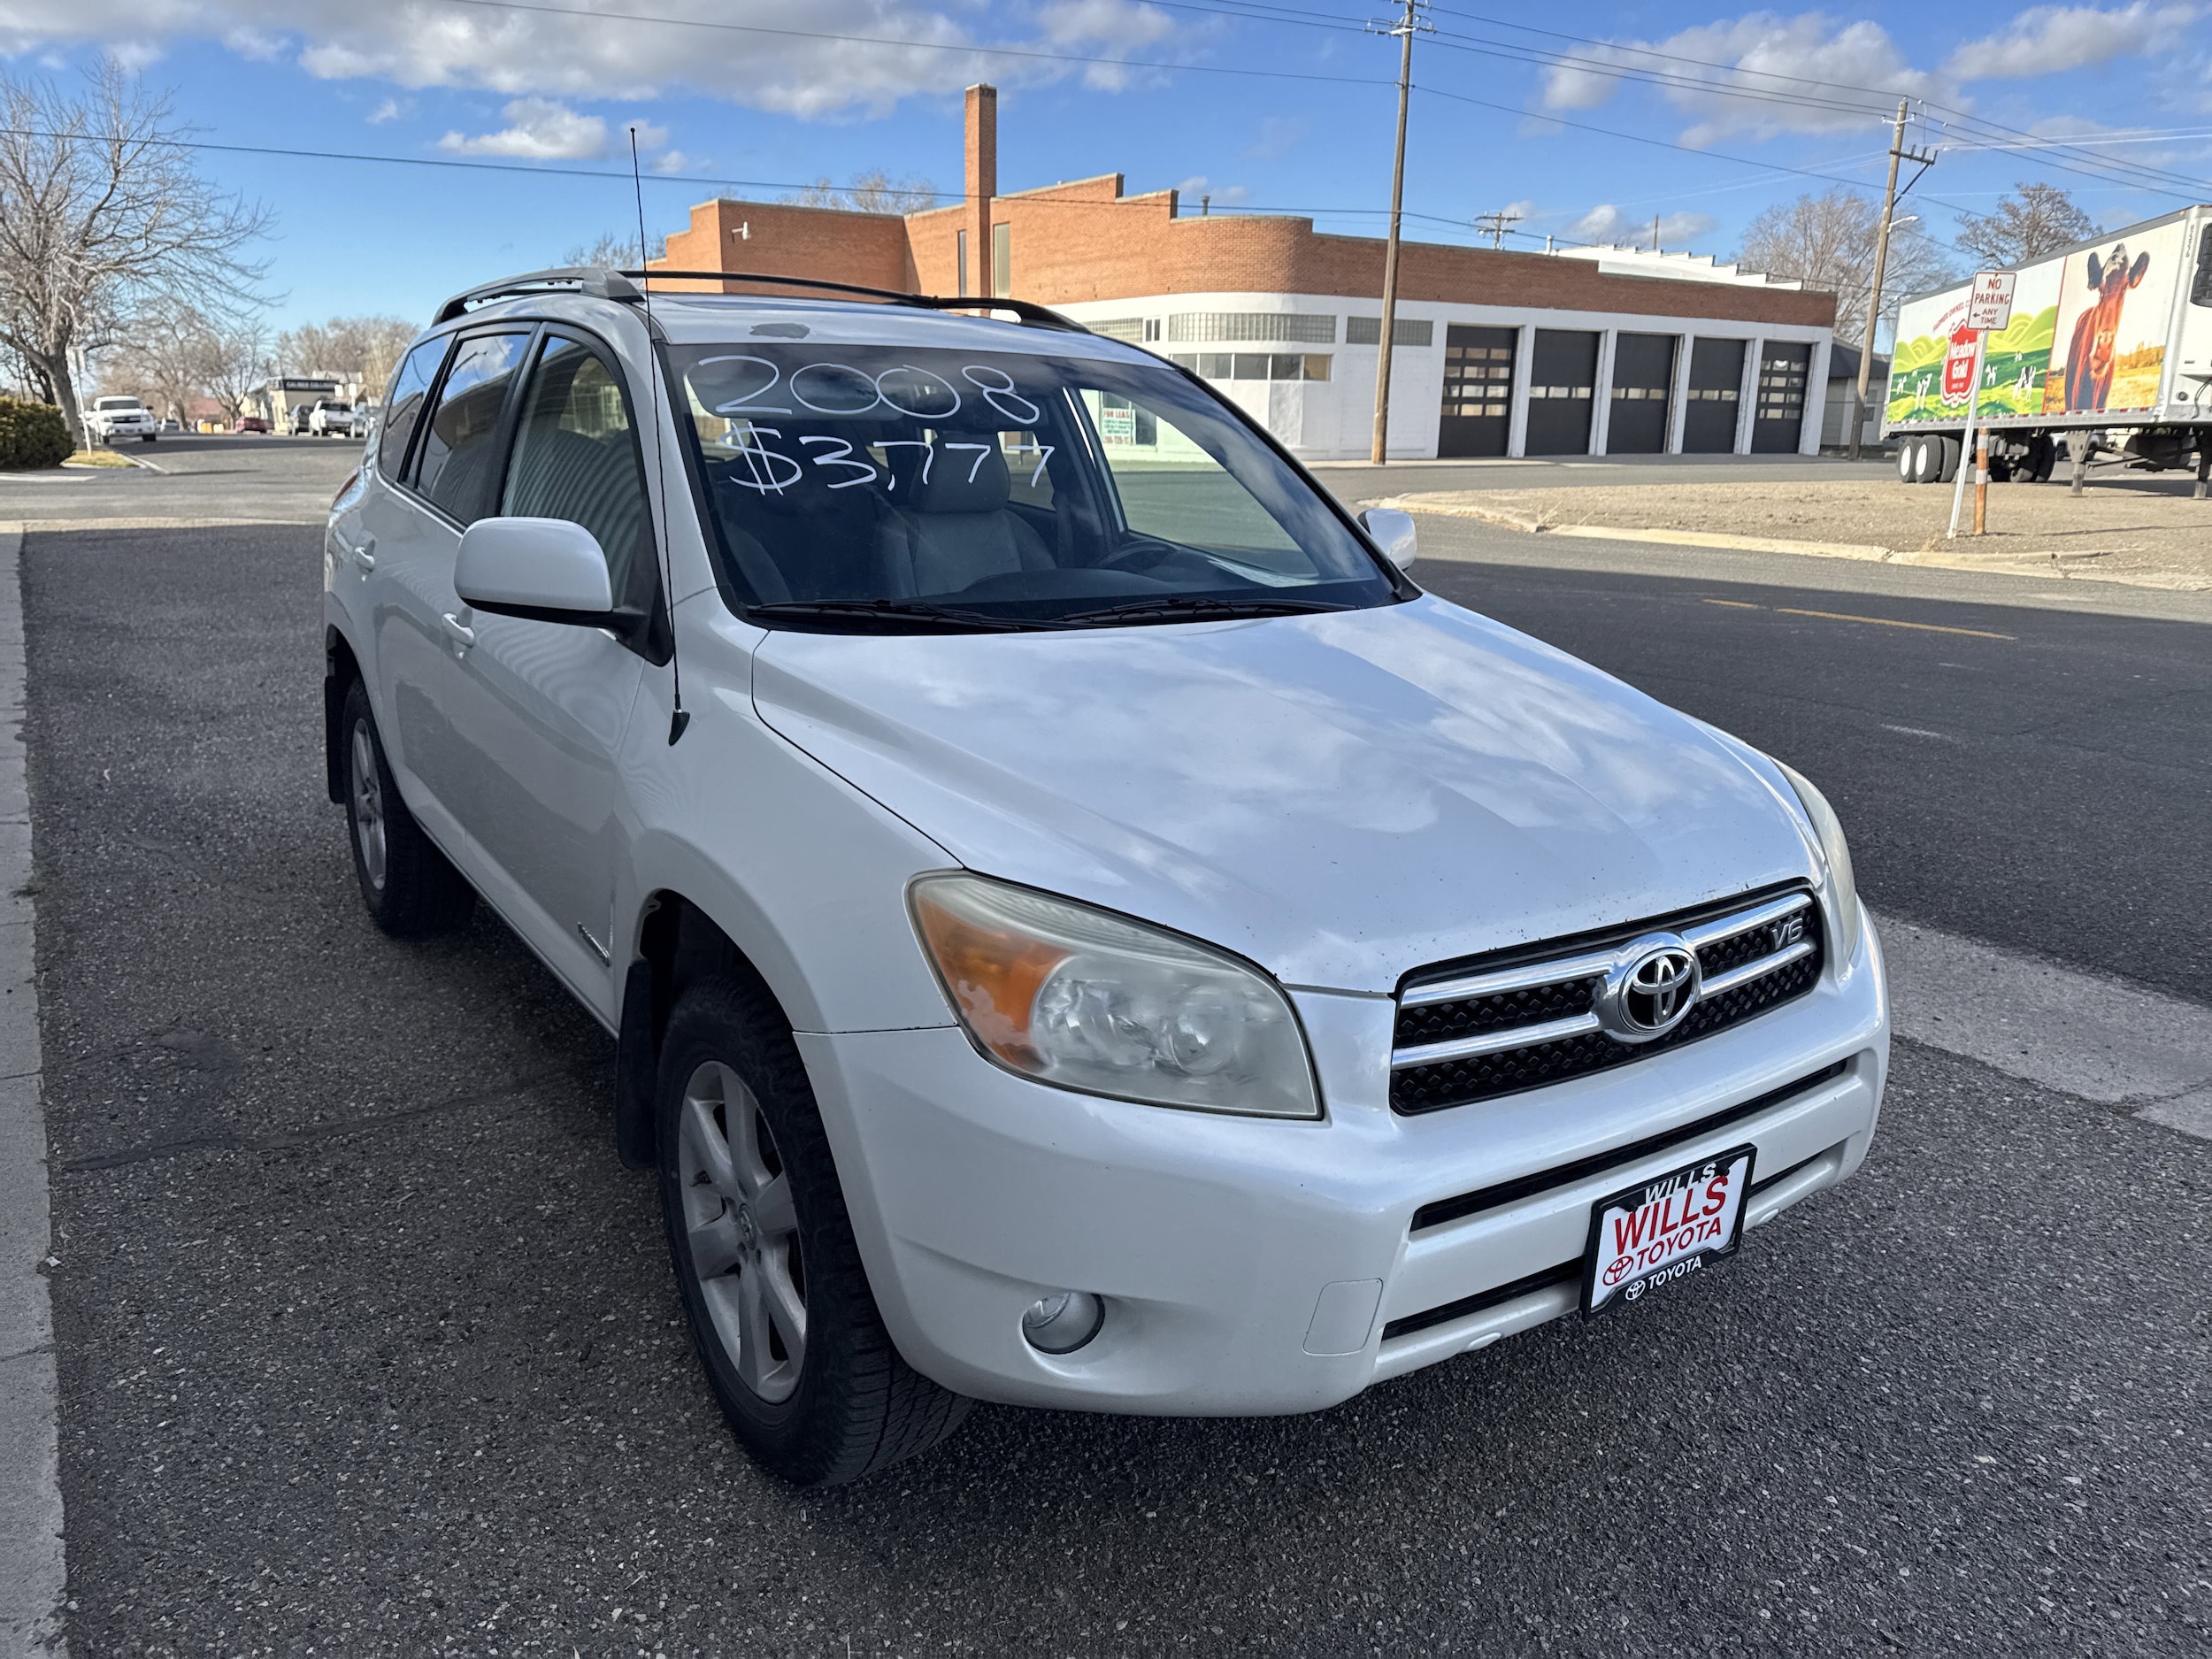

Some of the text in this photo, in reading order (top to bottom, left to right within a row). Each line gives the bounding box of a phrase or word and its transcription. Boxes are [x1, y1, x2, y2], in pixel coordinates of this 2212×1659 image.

[1974, 293, 2010, 304] PARKING
[1987, 278, 2002, 289] NO
[1949, 339, 1978, 360] Meadow
[1952, 358, 1970, 380] Gold
[698, 355, 1041, 425] 2008
[718, 421, 1056, 495] $3,777
[1771, 918, 1803, 950] V6
[1645, 1163, 1717, 1205] WILLS
[1615, 1176, 1729, 1256] WILLS
[1637, 1217, 1722, 1271] TOYOTA
[1648, 1255, 1702, 1290] TOYOTA
